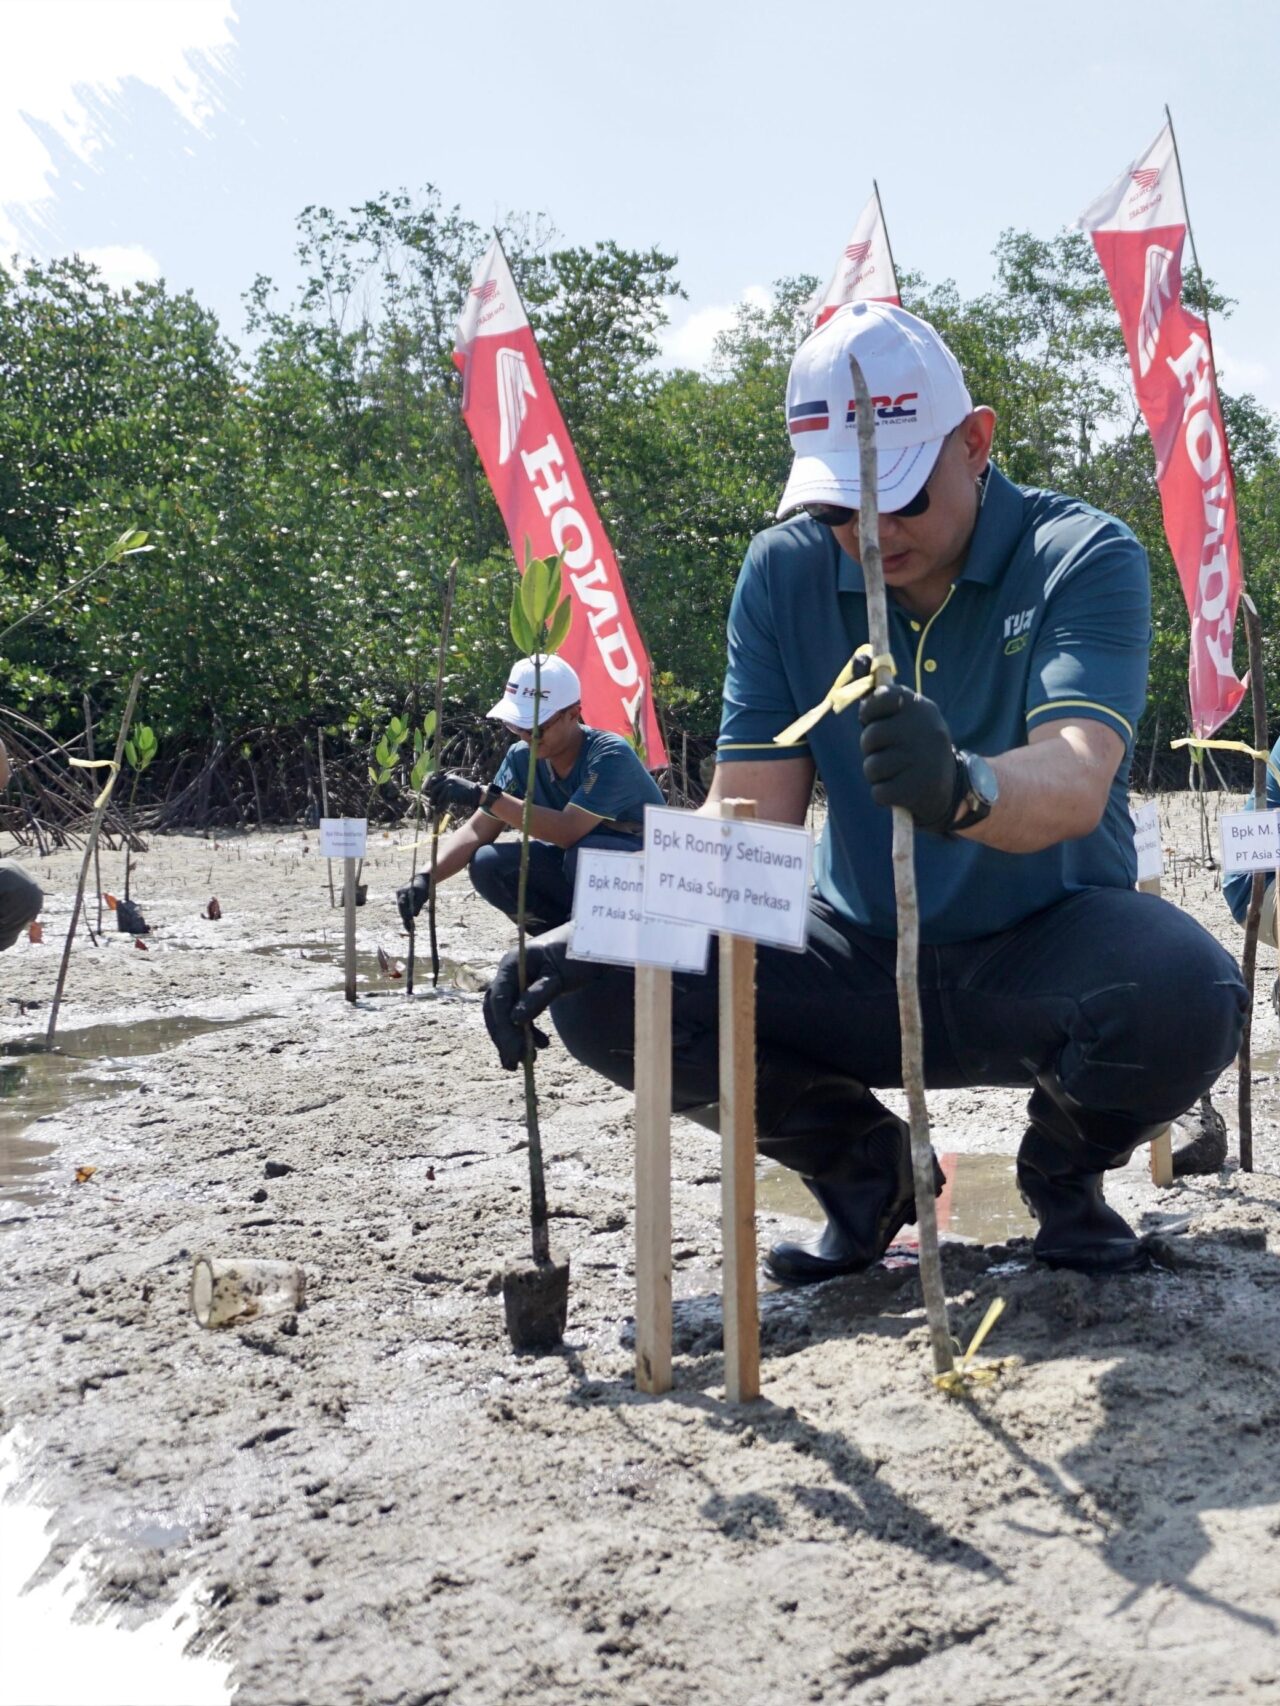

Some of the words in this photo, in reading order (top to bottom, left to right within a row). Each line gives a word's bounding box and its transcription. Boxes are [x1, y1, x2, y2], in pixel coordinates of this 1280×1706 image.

[522, 687, 552, 699] HC
[1231, 825, 1254, 840] Bpk
[1258, 825, 1274, 835] M.
[653, 828, 681, 851] Bpk
[685, 833, 733, 862] Ronny
[736, 842, 803, 870] Setiawan
[1235, 852, 1248, 861] PT
[1251, 850, 1272, 860] Asia
[588, 874, 610, 891] Bpk
[613, 877, 644, 893] Ronn
[659, 872, 675, 888] PT
[677, 876, 703, 895] Asia
[706, 881, 740, 904] Surya
[743, 887, 791, 911] Perkasa
[591, 905, 604, 917] PT
[606, 907, 626, 920] Asia
